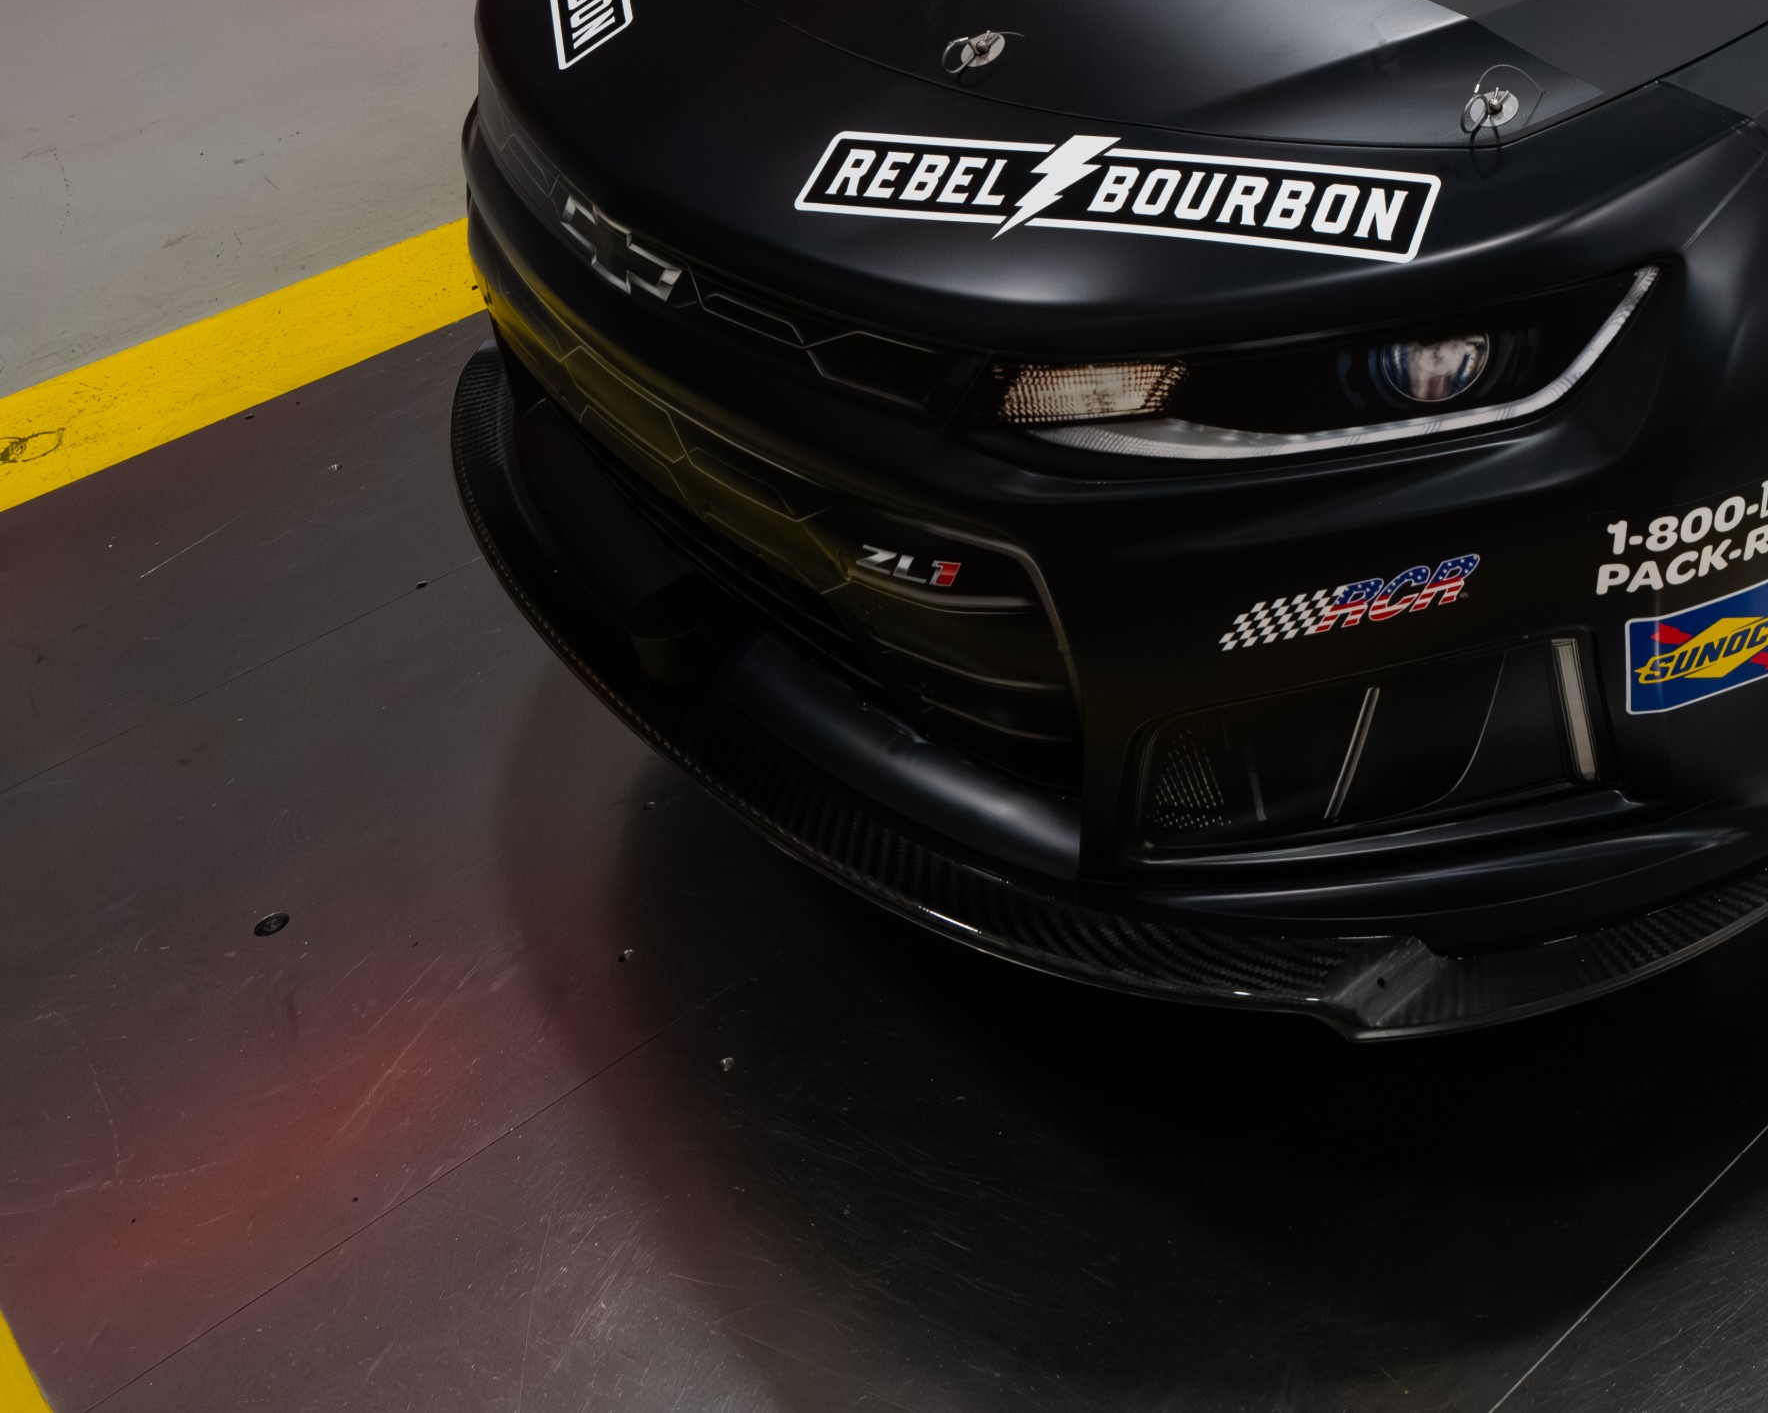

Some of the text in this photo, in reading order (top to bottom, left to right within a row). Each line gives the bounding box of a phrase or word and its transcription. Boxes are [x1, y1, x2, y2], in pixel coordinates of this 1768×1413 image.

[824, 148, 1411, 242] REBEL BOURBON
[854, 543, 963, 587] ZL1
[1313, 552, 1481, 635] RCR
